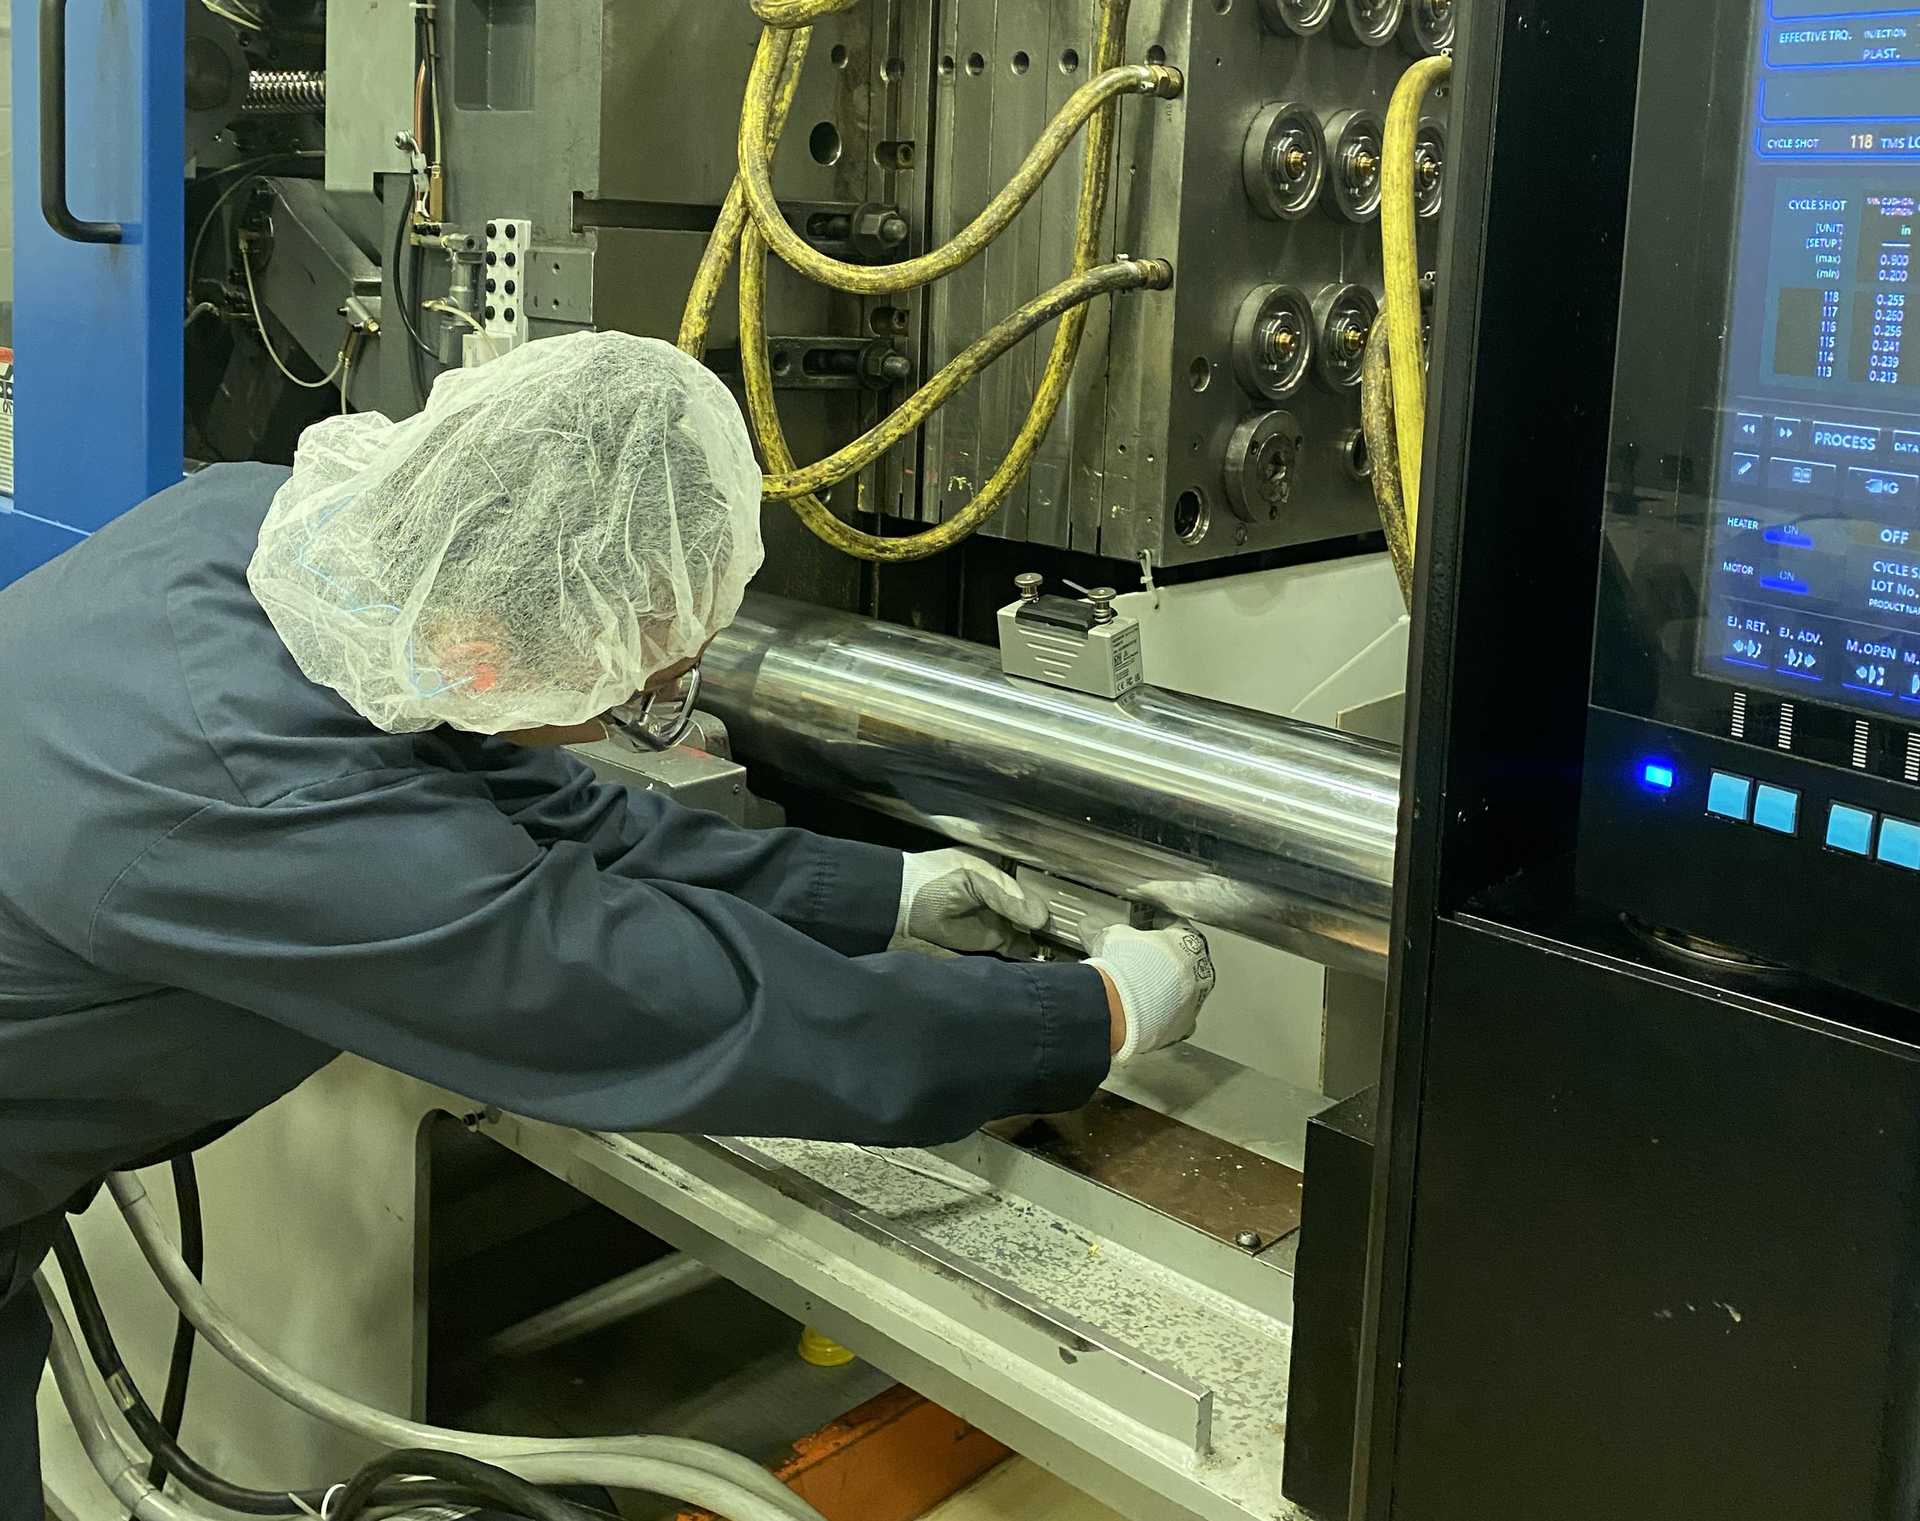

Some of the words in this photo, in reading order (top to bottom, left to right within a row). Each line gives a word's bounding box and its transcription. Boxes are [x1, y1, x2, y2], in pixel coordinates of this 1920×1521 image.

[1779, 30, 1827, 43] EFFECTIVE
[1864, 28, 1906, 39] INJECTION
[1863, 48, 1900, 60] PLAST.
[1767, 138, 1793, 149] CYCLE
[1795, 138, 1819, 149] SHOT
[1850, 134, 1873, 149] 118
[1881, 138, 1905, 149] TMS
[1788, 199, 1817, 211] CYCLE
[1818, 199, 1847, 211] SHOT
[1901, 224, 1911, 235] in
[1815, 254, 1841, 265] (max)
[1878, 269, 1908, 282] 0.200
[1824, 290, 1840, 303] 118
[1876, 293, 1905, 306] 0.255
[1822, 306, 1839, 317] 117
[1819, 336, 1835, 348] 115
[1816, 366, 1832, 378] 113
[1814, 431, 1876, 451] PROCESS
[1894, 442, 1919, 453] DATA
[1727, 517, 1758, 530] HEATER
[1880, 529, 1909, 544] OFF
[1723, 561, 1754, 575] MOTOR
[1873, 561, 1909, 577] CYCLE
[1871, 579, 1894, 593] LOT
[1896, 584, 1919, 599] No.
[1868, 598, 1905, 612] PRODUCT
[1727, 616, 1742, 630] EJ.
[1746, 620, 1770, 635] RET.
[1779, 627, 1794, 640] EJ.
[1797, 631, 1824, 646] ADV.
